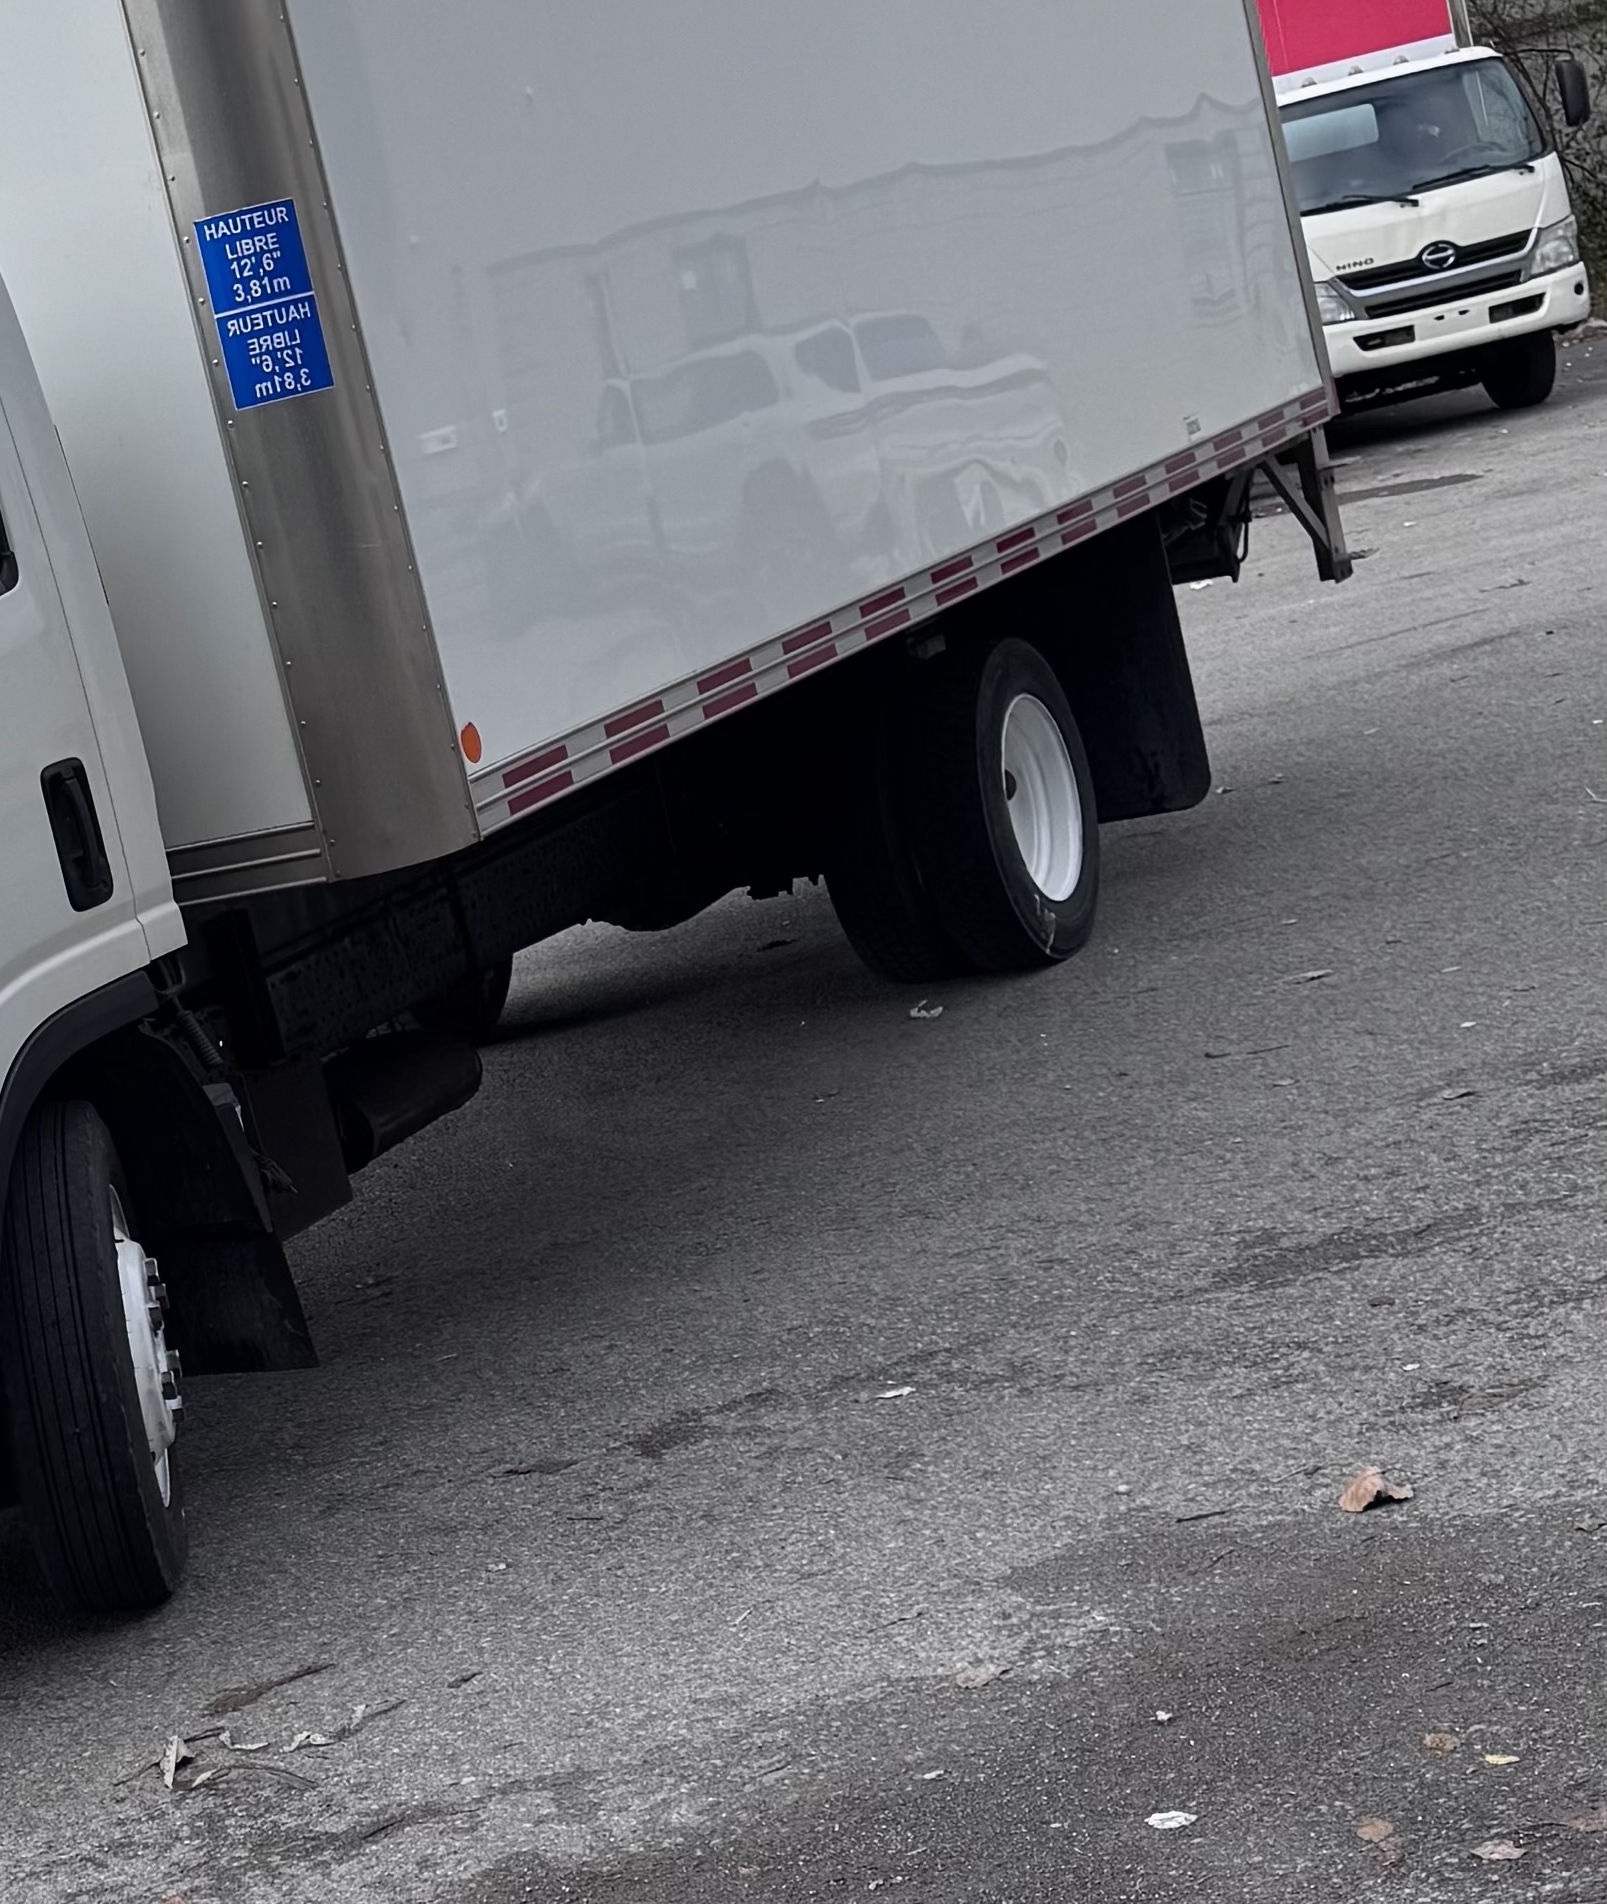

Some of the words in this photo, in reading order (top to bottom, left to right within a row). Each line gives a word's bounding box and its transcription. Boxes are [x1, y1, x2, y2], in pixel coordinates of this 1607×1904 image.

[203, 207, 289, 241] HAUTEUR
[225, 232, 279, 260] LIBRE
[1336, 257, 1374, 271] HINO
[233, 276, 291, 303] 3,81m
